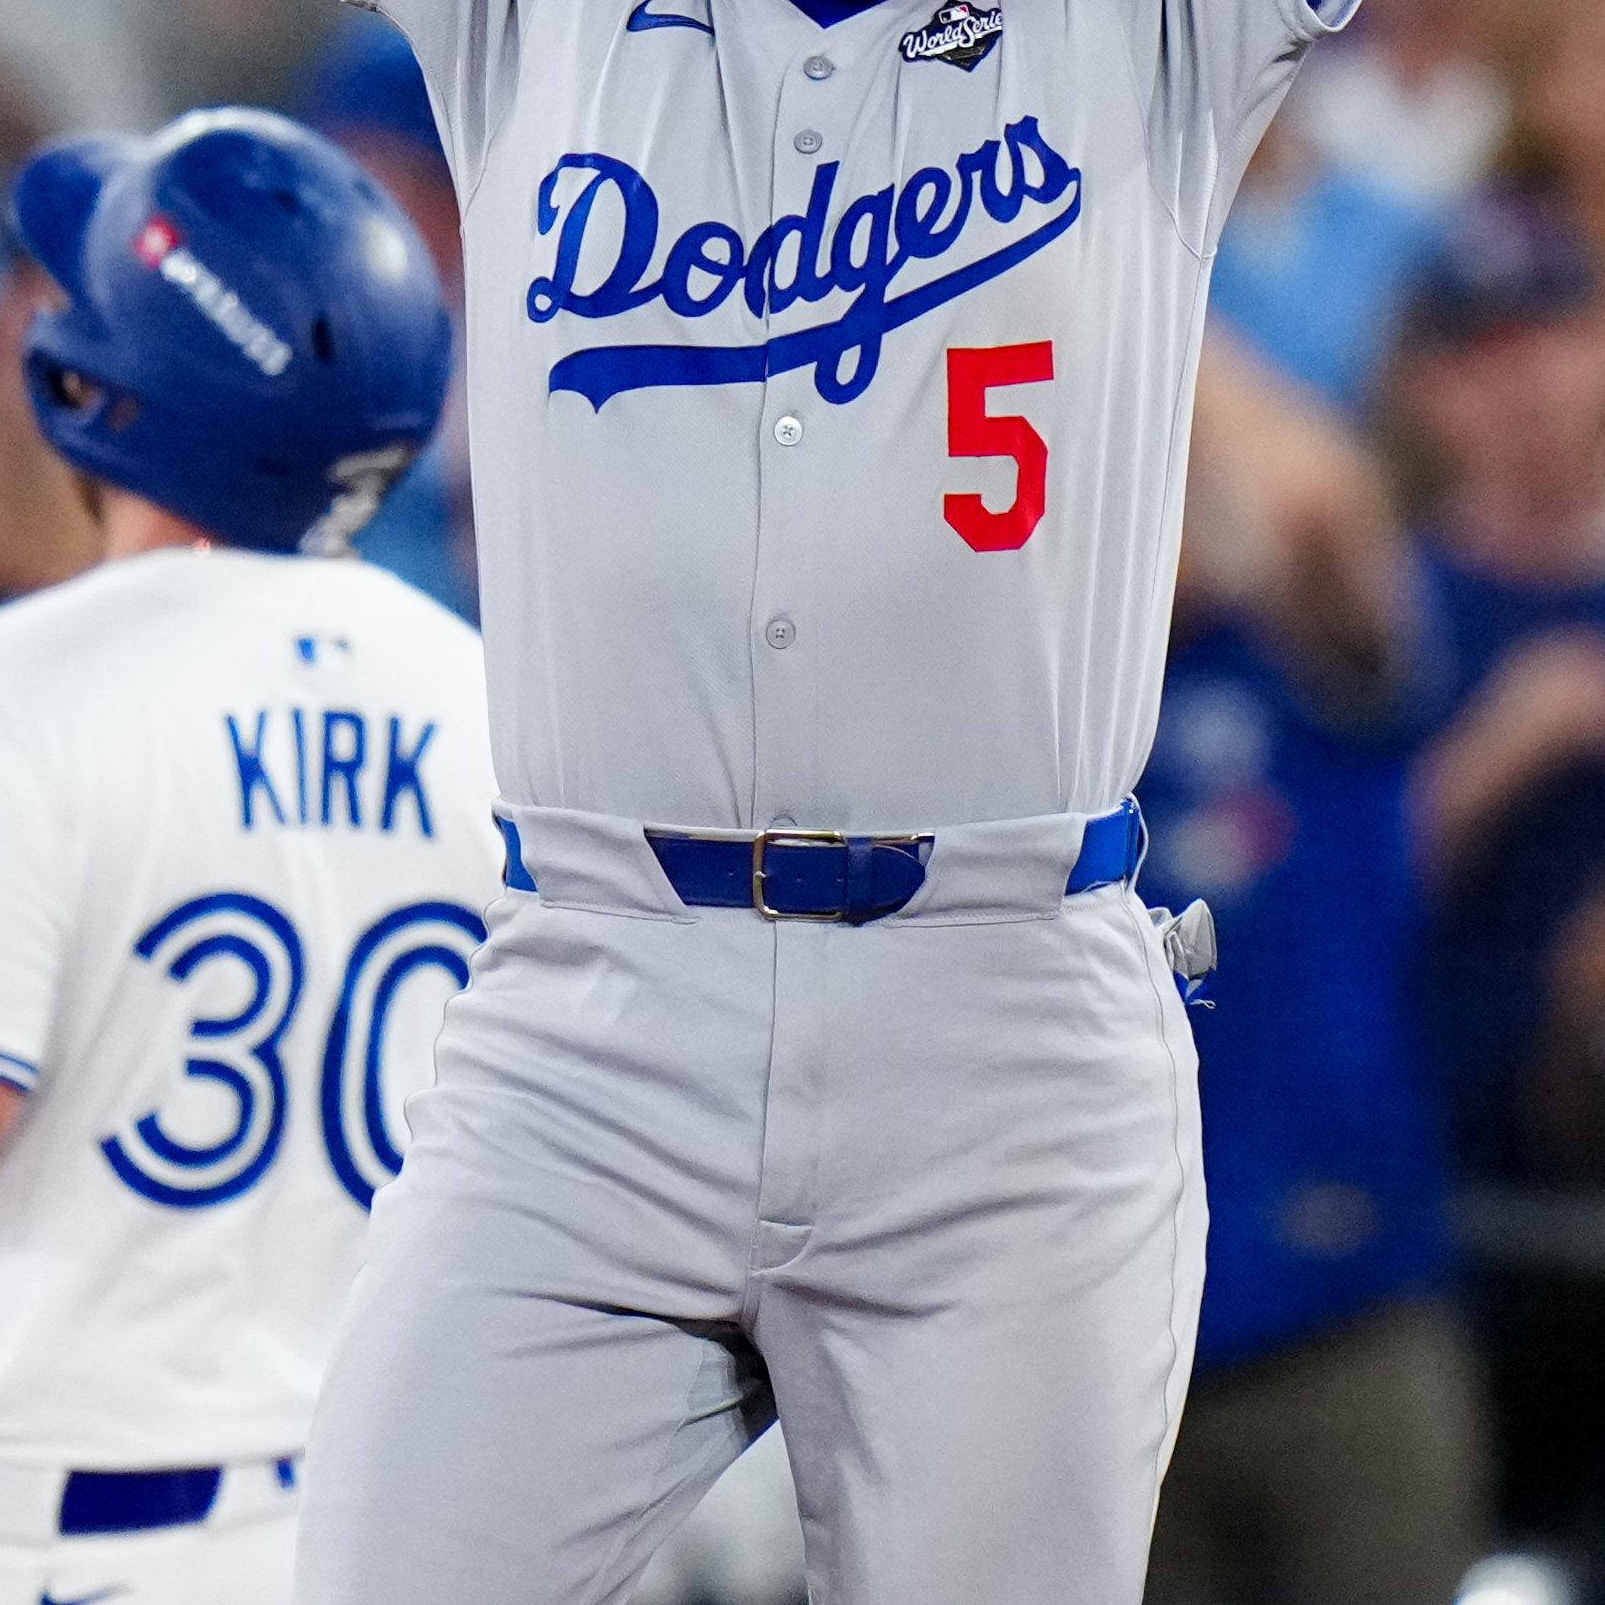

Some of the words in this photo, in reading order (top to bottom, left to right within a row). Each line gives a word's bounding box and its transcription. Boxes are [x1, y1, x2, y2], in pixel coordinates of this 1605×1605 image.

[903, 21, 964, 58] World
[958, 10, 1003, 49] Serie
[527, 116, 1082, 406] Dodgers
[944, 340, 1055, 552] 5
[224, 707, 440, 839] KIRK
[100, 892, 489, 1215] 30
